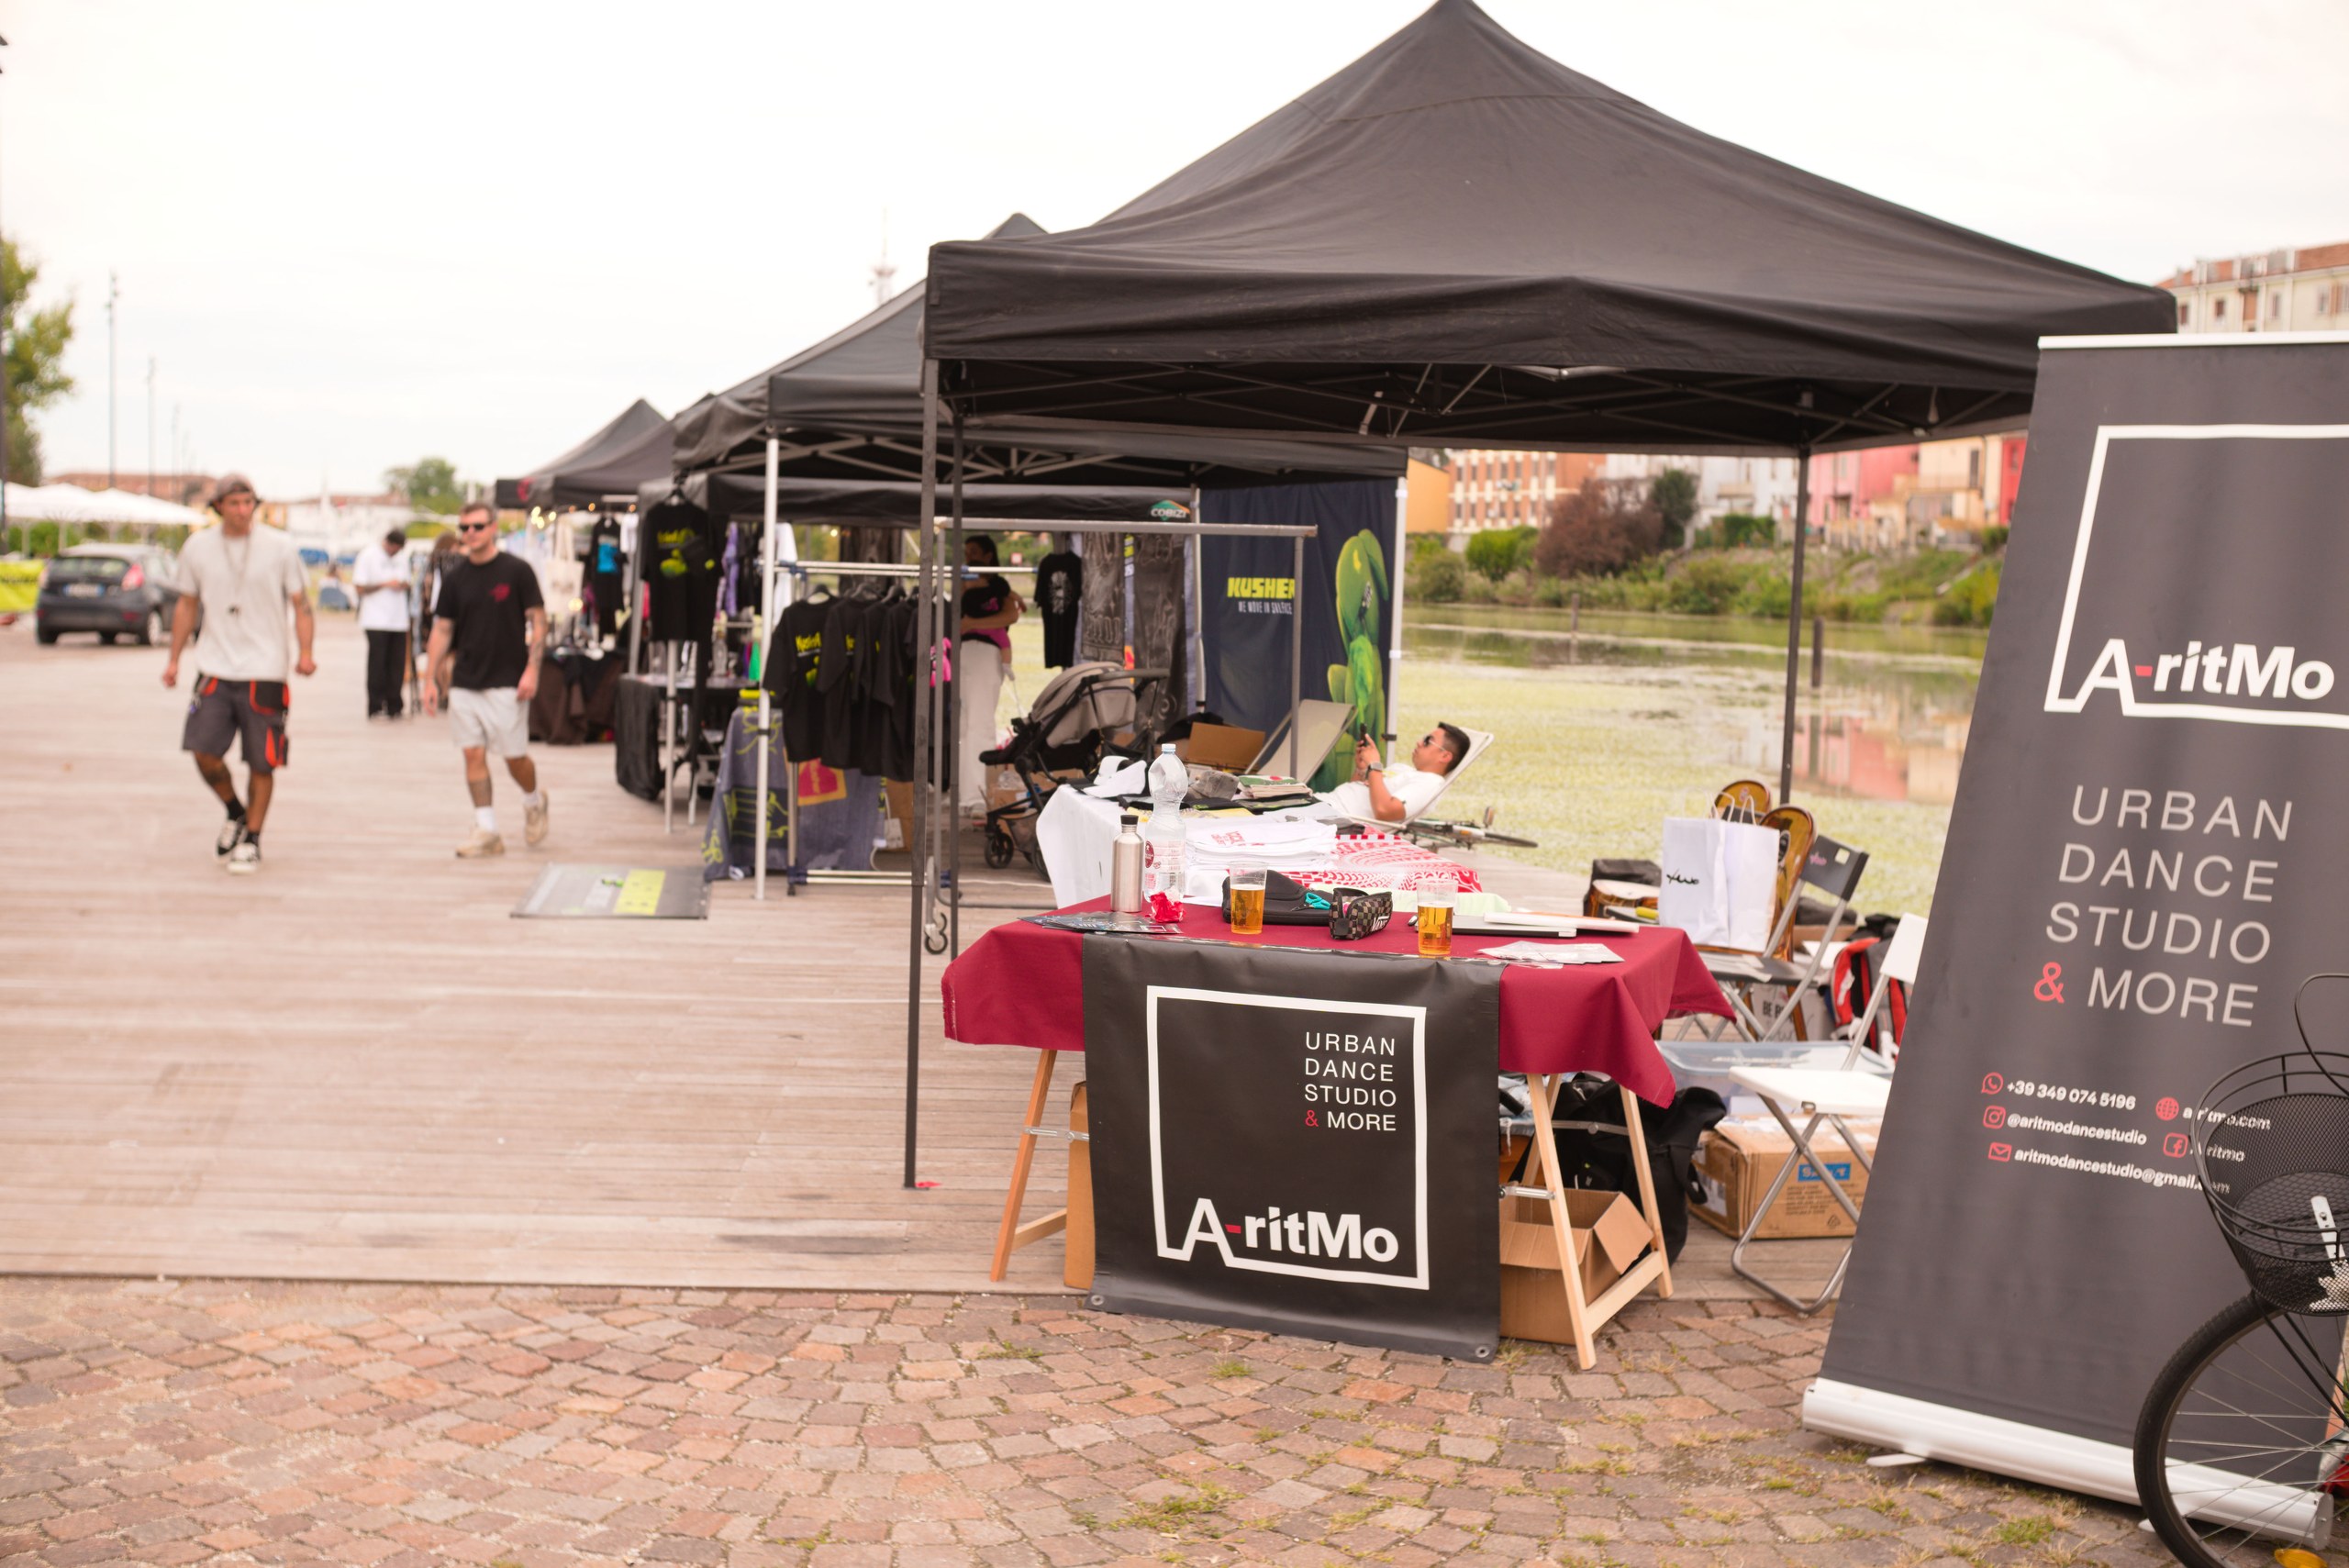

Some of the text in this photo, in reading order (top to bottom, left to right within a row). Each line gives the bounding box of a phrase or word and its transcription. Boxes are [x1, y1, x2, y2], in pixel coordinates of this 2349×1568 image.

[2071, 784, 2292, 841] URBAN
[2058, 842, 2278, 903] DANCE
[2045, 902, 2271, 964] STUDIO
[2033, 962, 2259, 1028] & MORE
[1305, 1031, 1396, 1056] URBAN
[1305, 1058, 1394, 1082] DANCE
[1304, 1084, 1397, 1107] STUDIO
[2007, 1080, 2137, 1111] +39 349 074 5196
[1304, 1109, 1397, 1131] & MORE
[2007, 1113, 2147, 1146] @aritmodancestudio
[1181, 1197, 1399, 1266] A-ritMo
